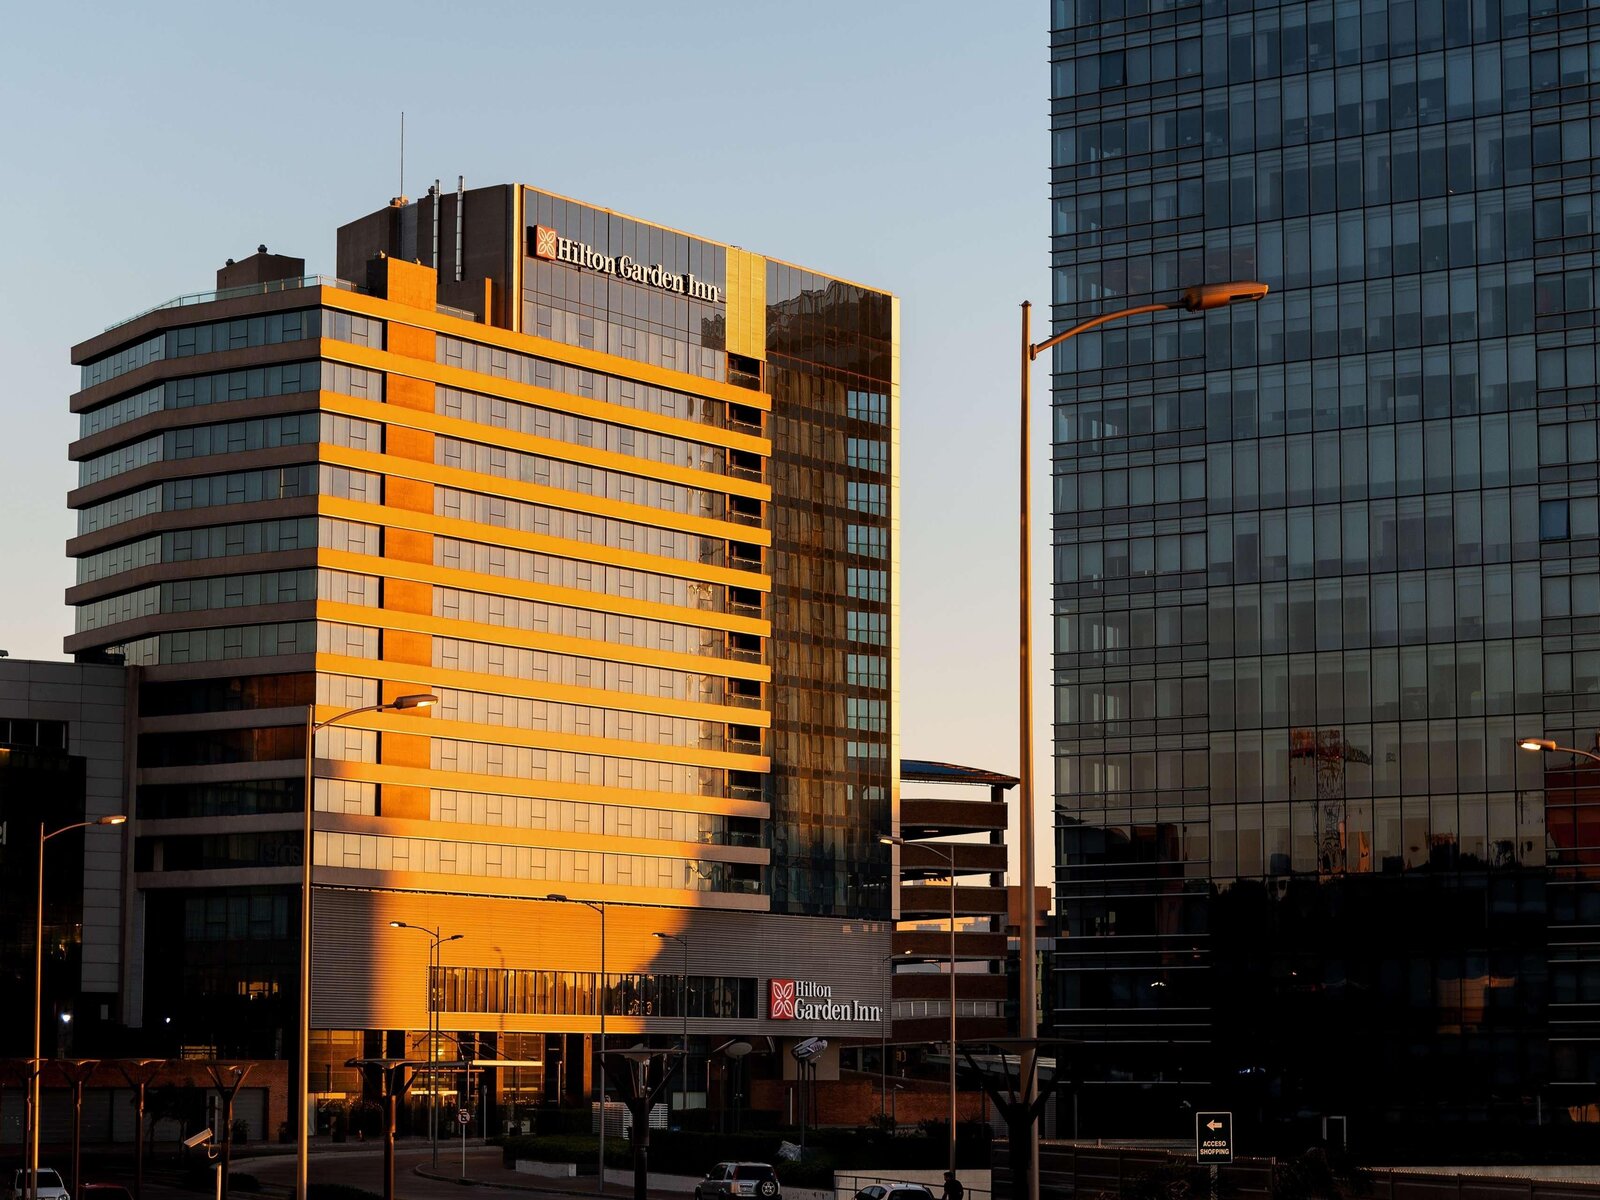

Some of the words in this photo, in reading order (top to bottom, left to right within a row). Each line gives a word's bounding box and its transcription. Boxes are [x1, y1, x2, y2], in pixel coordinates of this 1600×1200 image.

[557, 236, 616, 274] Hilton
[619, 255, 684, 294] Garden
[687, 273, 721, 303] Inn
[795, 980, 831, 997] Hilton
[794, 998, 851, 1021] Garden
[852, 1000, 881, 1022] Inn
